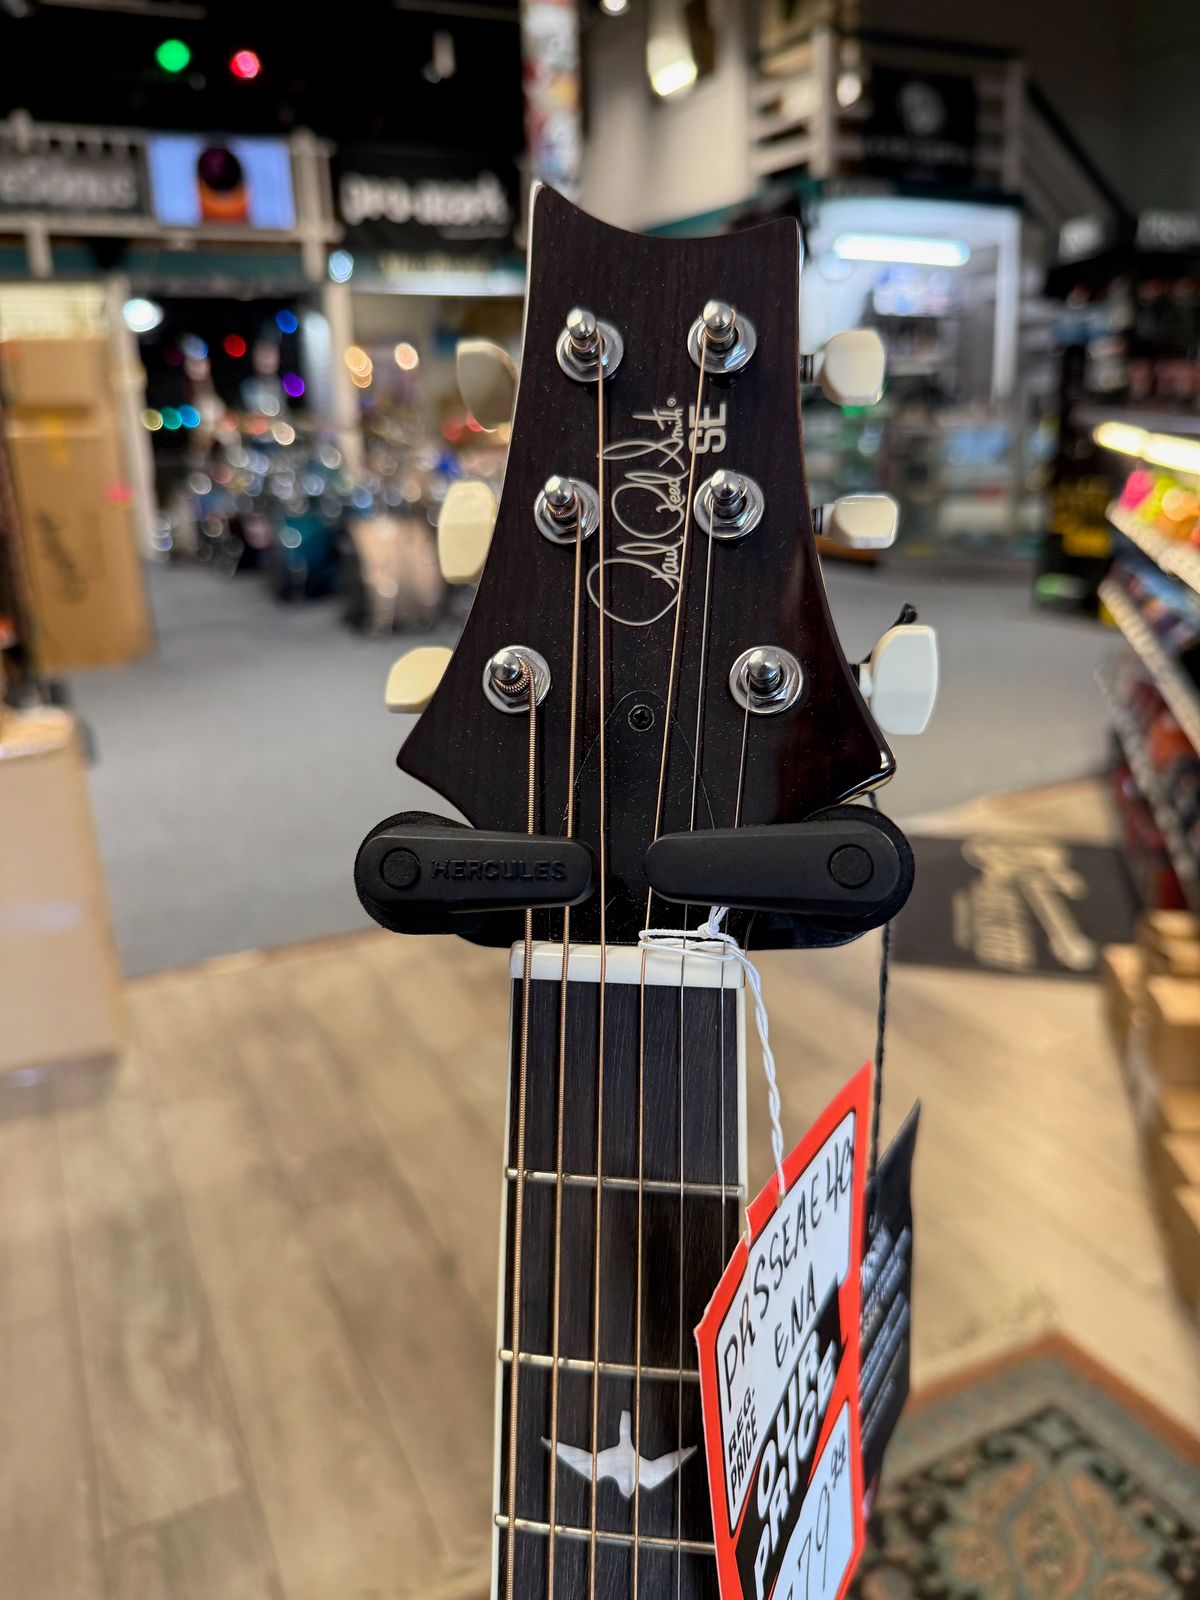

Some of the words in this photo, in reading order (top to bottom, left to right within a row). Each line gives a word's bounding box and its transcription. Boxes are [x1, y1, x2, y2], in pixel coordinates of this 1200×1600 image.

[689, 400, 727, 454] SE
[611, 470, 689, 539] Reed
[586, 535, 684, 627] Paul
[431, 859, 567, 880] HERCULES
[728, 1386, 756, 1461] REG.
[730, 1405, 758, 1507] PRICE
[757, 1329, 821, 1521] OUR
[754, 1339, 837, 1600] PRICE
